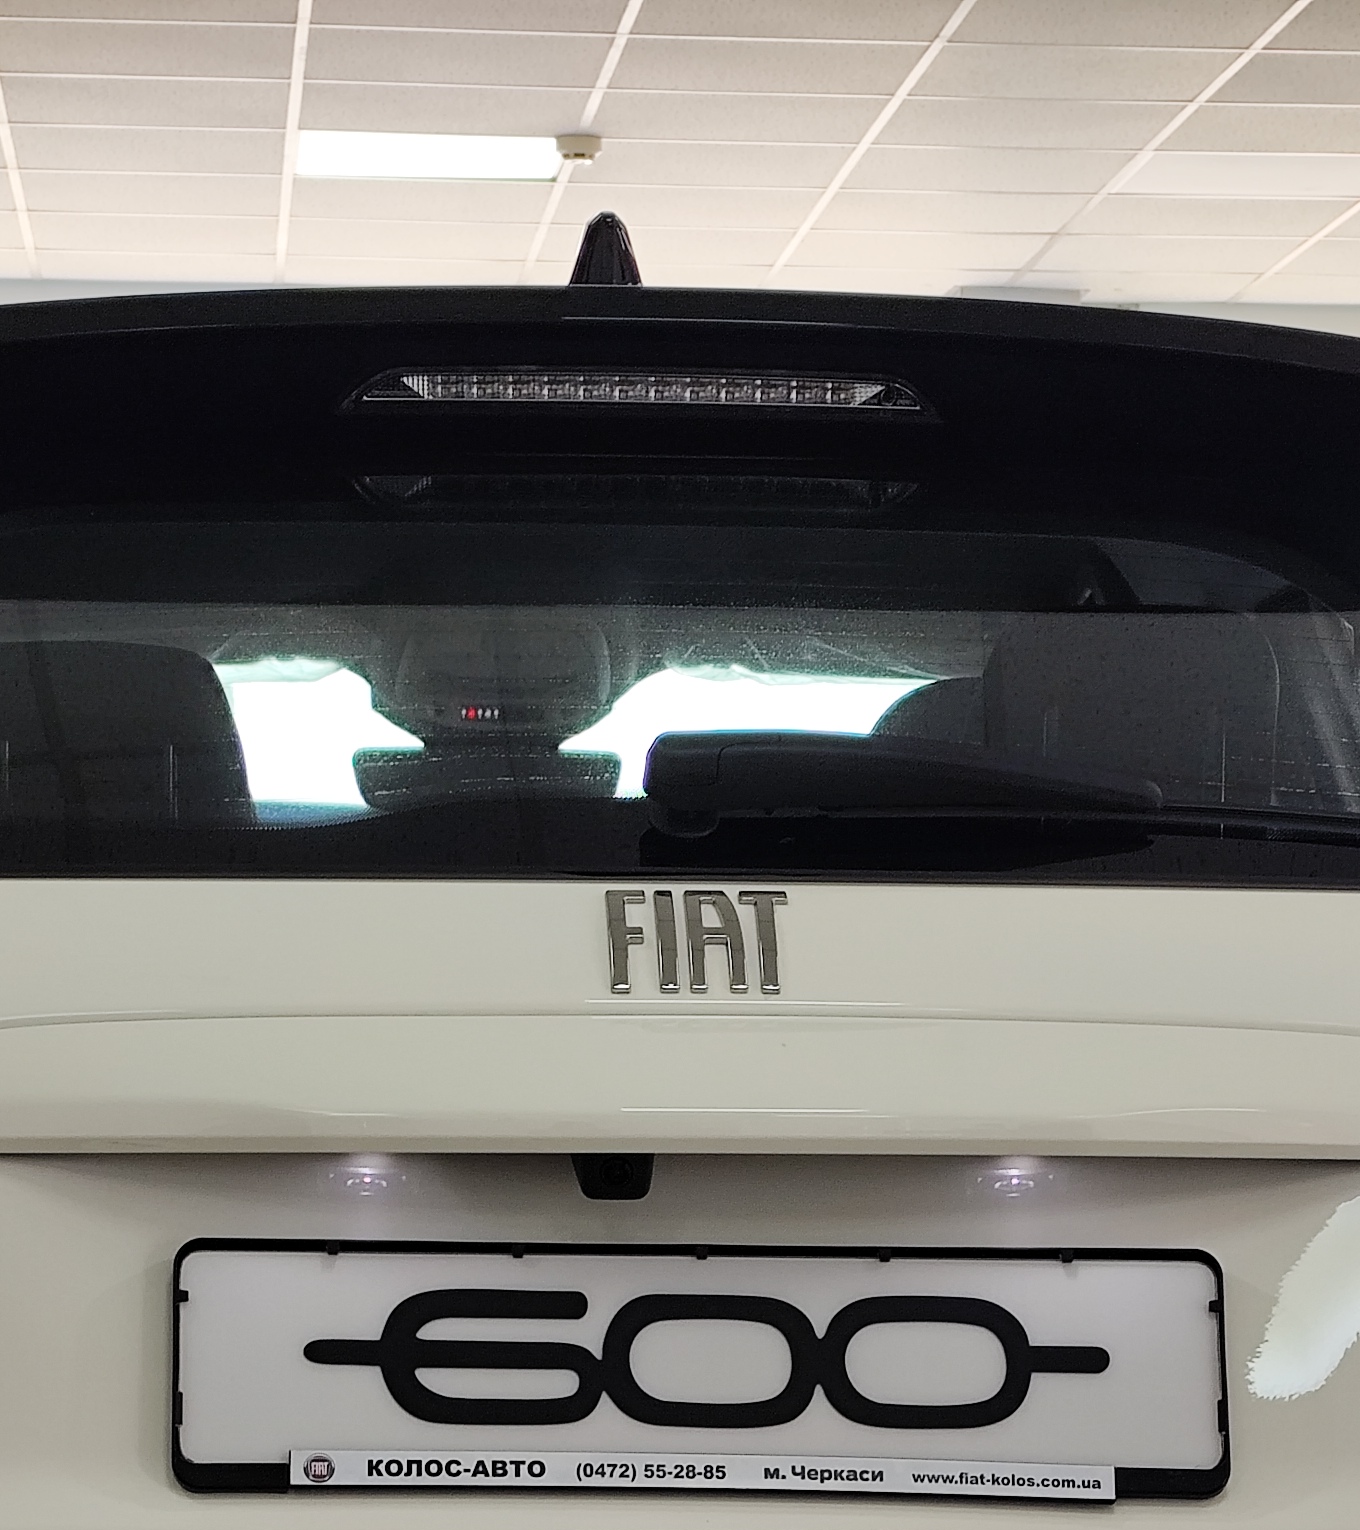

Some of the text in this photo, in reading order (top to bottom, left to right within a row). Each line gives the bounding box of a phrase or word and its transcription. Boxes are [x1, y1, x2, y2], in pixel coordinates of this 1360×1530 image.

[605, 889, 788, 994] FIAT
[379, 1288, 1032, 1429] 600
[366, 1458, 547, 1479] КОЛОС-АВТО
[576, 1461, 638, 1482] (0472)
[643, 1463, 727, 1481] 55-28-85
[790, 1465, 885, 1484] Черкаси
[911, 1470, 1102, 1491] www.fiat-kolos.com.ua
